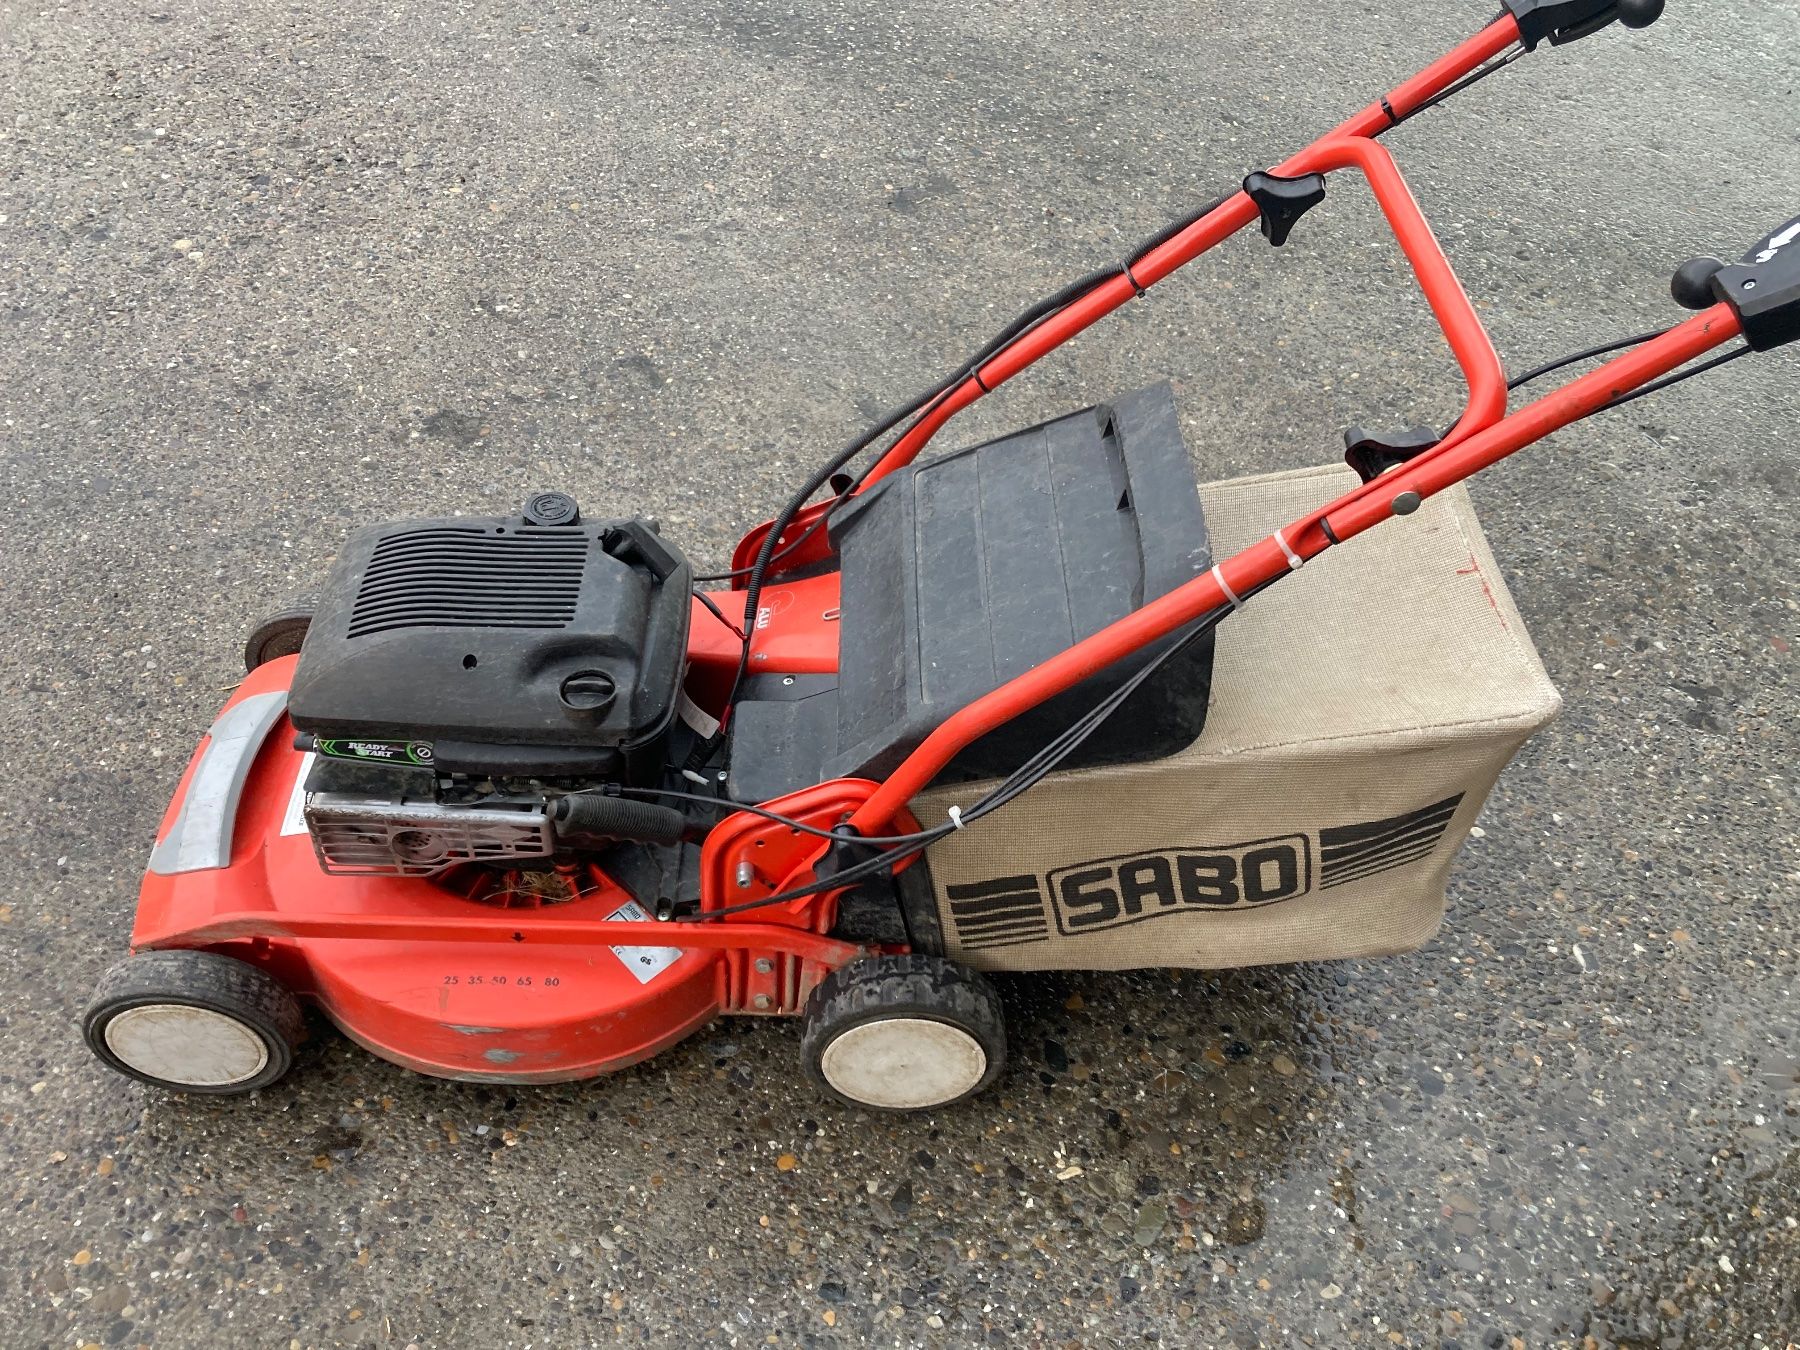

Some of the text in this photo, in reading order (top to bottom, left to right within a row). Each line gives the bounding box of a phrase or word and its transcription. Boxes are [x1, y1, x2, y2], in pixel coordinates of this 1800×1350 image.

[757, 607, 771, 629] ALU
[348, 742, 389, 751] READY
[357, 747, 394, 758] START
[1060, 844, 1298, 927] SABO
[625, 904, 641, 920] SABO
[443, 975, 560, 987] 25 35 50 65 80
